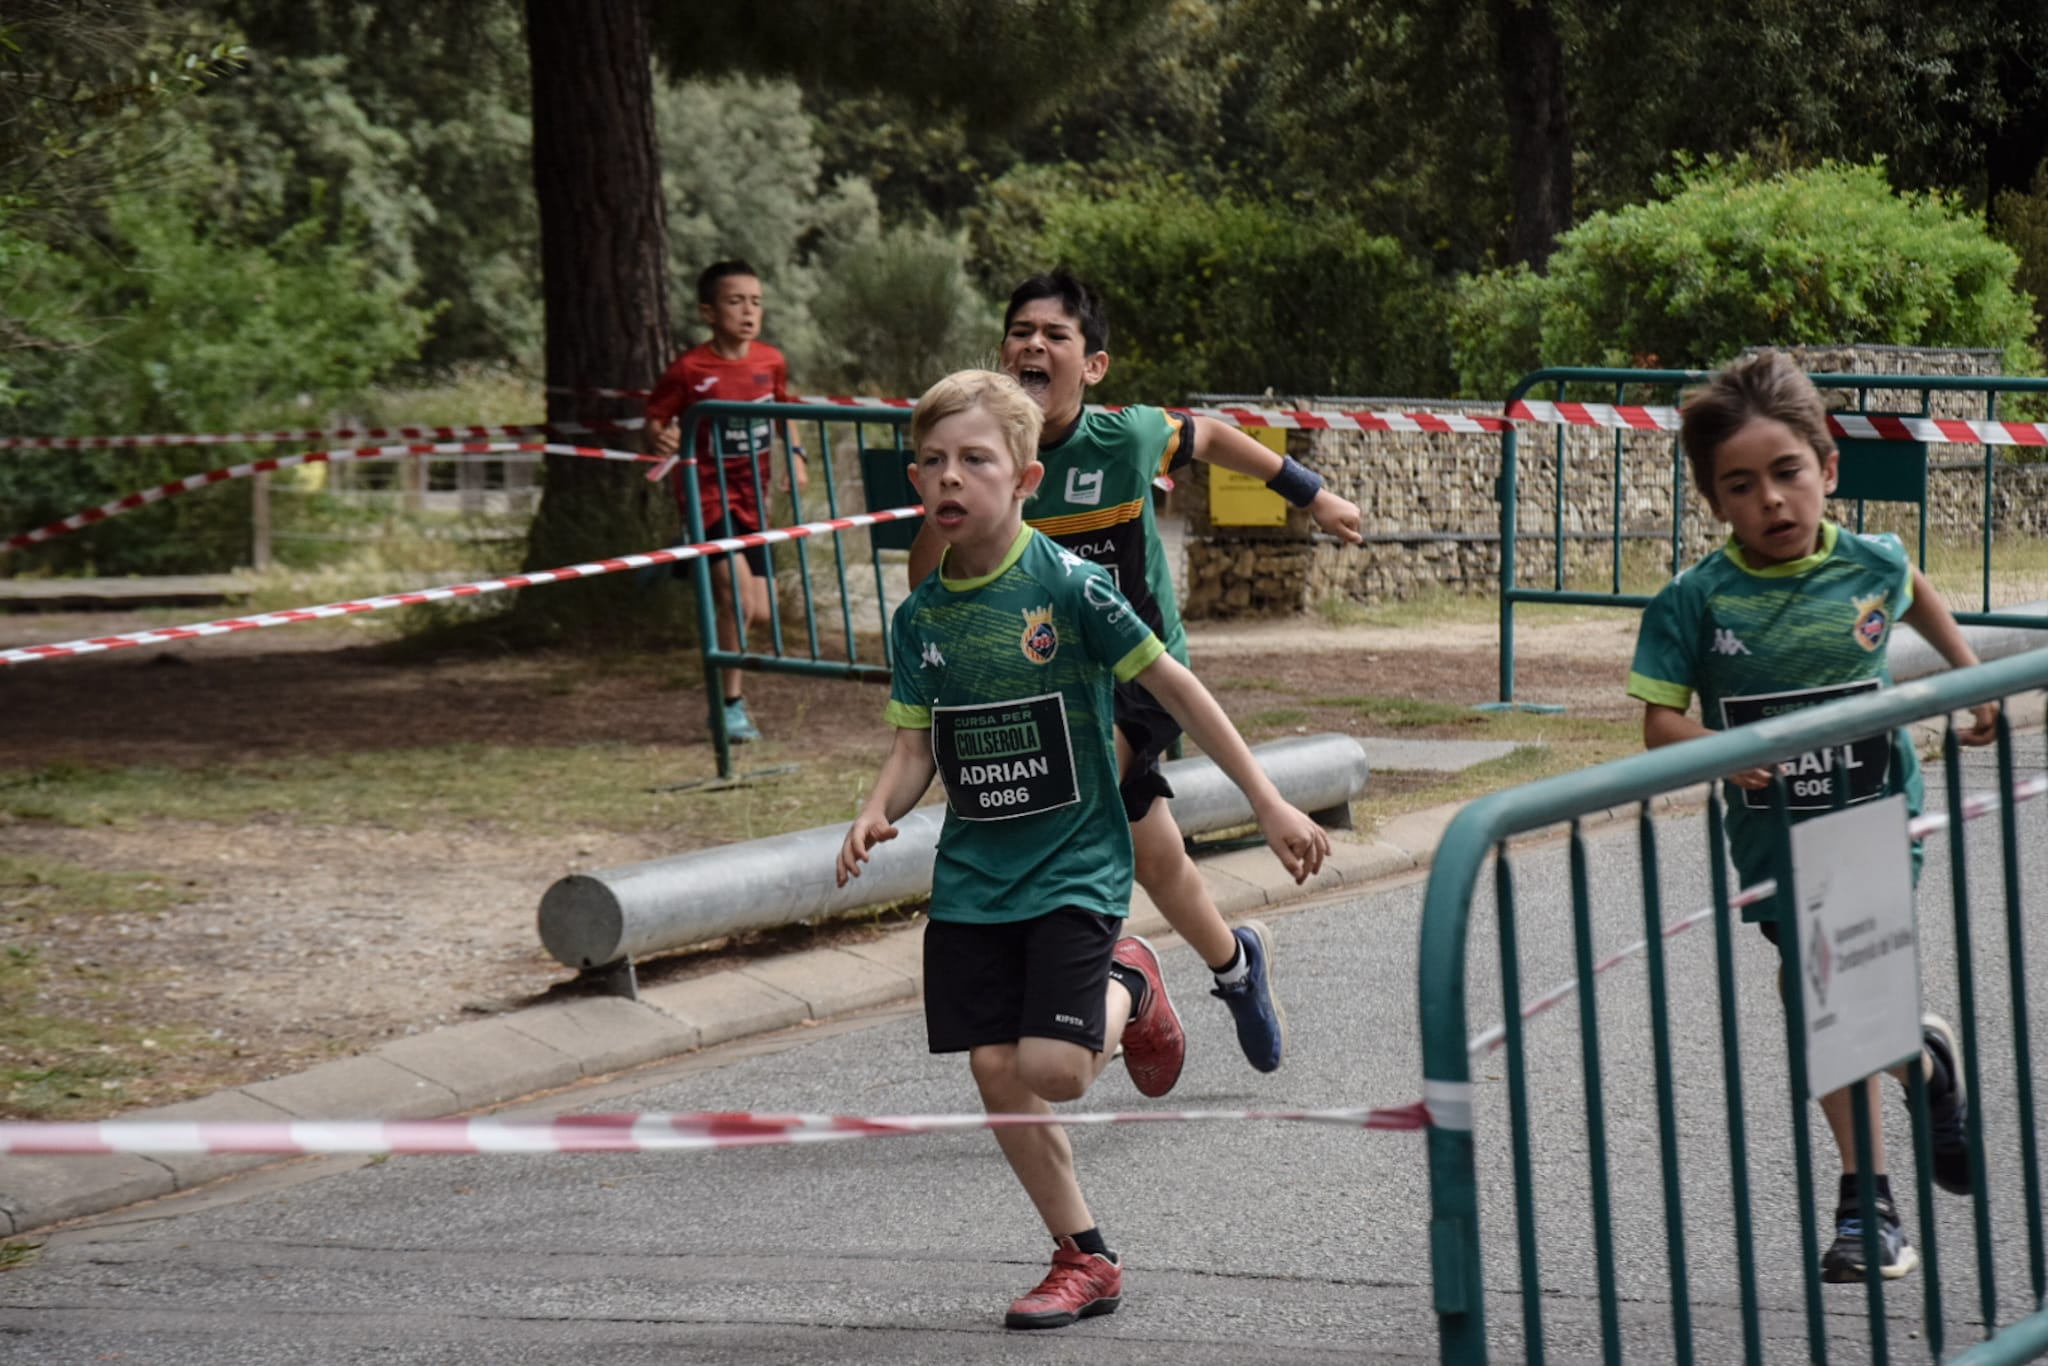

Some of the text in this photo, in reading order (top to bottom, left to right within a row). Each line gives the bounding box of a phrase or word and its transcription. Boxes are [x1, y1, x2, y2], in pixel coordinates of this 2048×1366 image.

[954, 710, 1032, 728] CURSA PER
[956, 725, 1038, 757] COLLSEROLA
[960, 756, 1049, 785] ADRIAN
[979, 787, 1030, 808] 6086
[1055, 1013, 1084, 1026] KIPSTA
